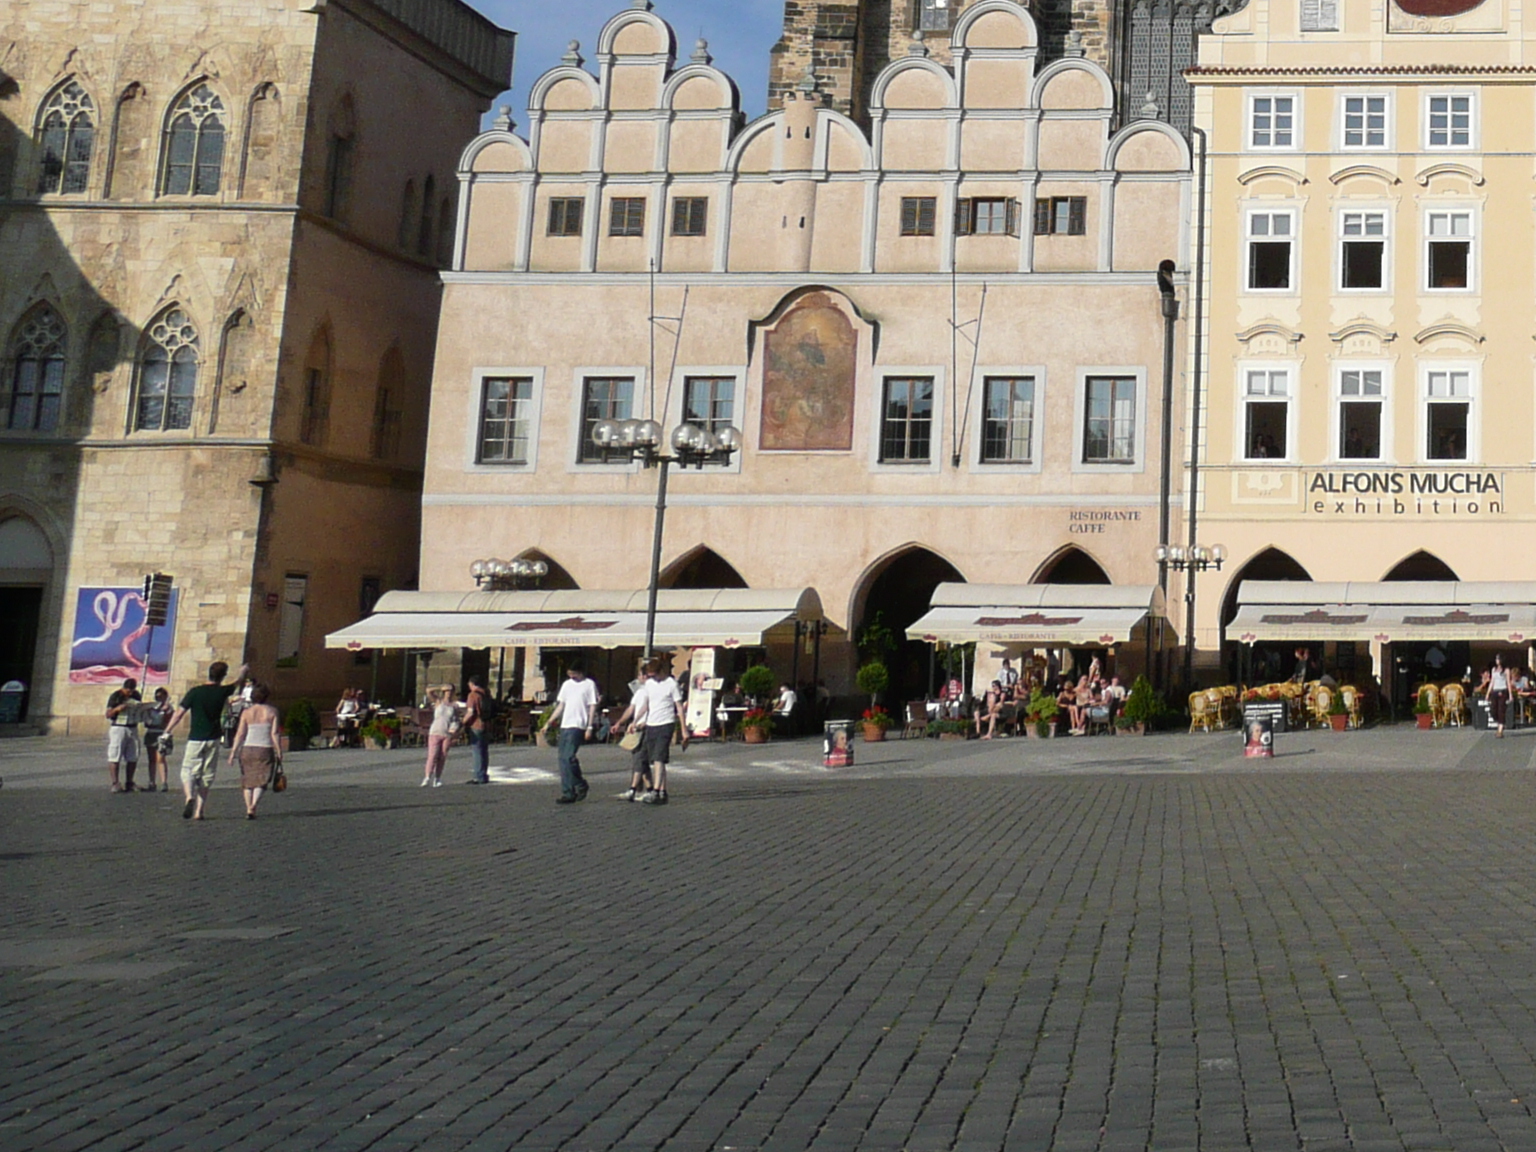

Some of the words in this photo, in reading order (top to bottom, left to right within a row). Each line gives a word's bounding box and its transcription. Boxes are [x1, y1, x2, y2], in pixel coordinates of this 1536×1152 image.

[1309, 473, 1404, 494] ALFONS
[1410, 473, 1501, 494] MUCHA
[1313, 498, 1501, 514] exhibition
[1069, 511, 1142, 521] RISTORANTE
[1069, 523, 1106, 534] CAFFE
